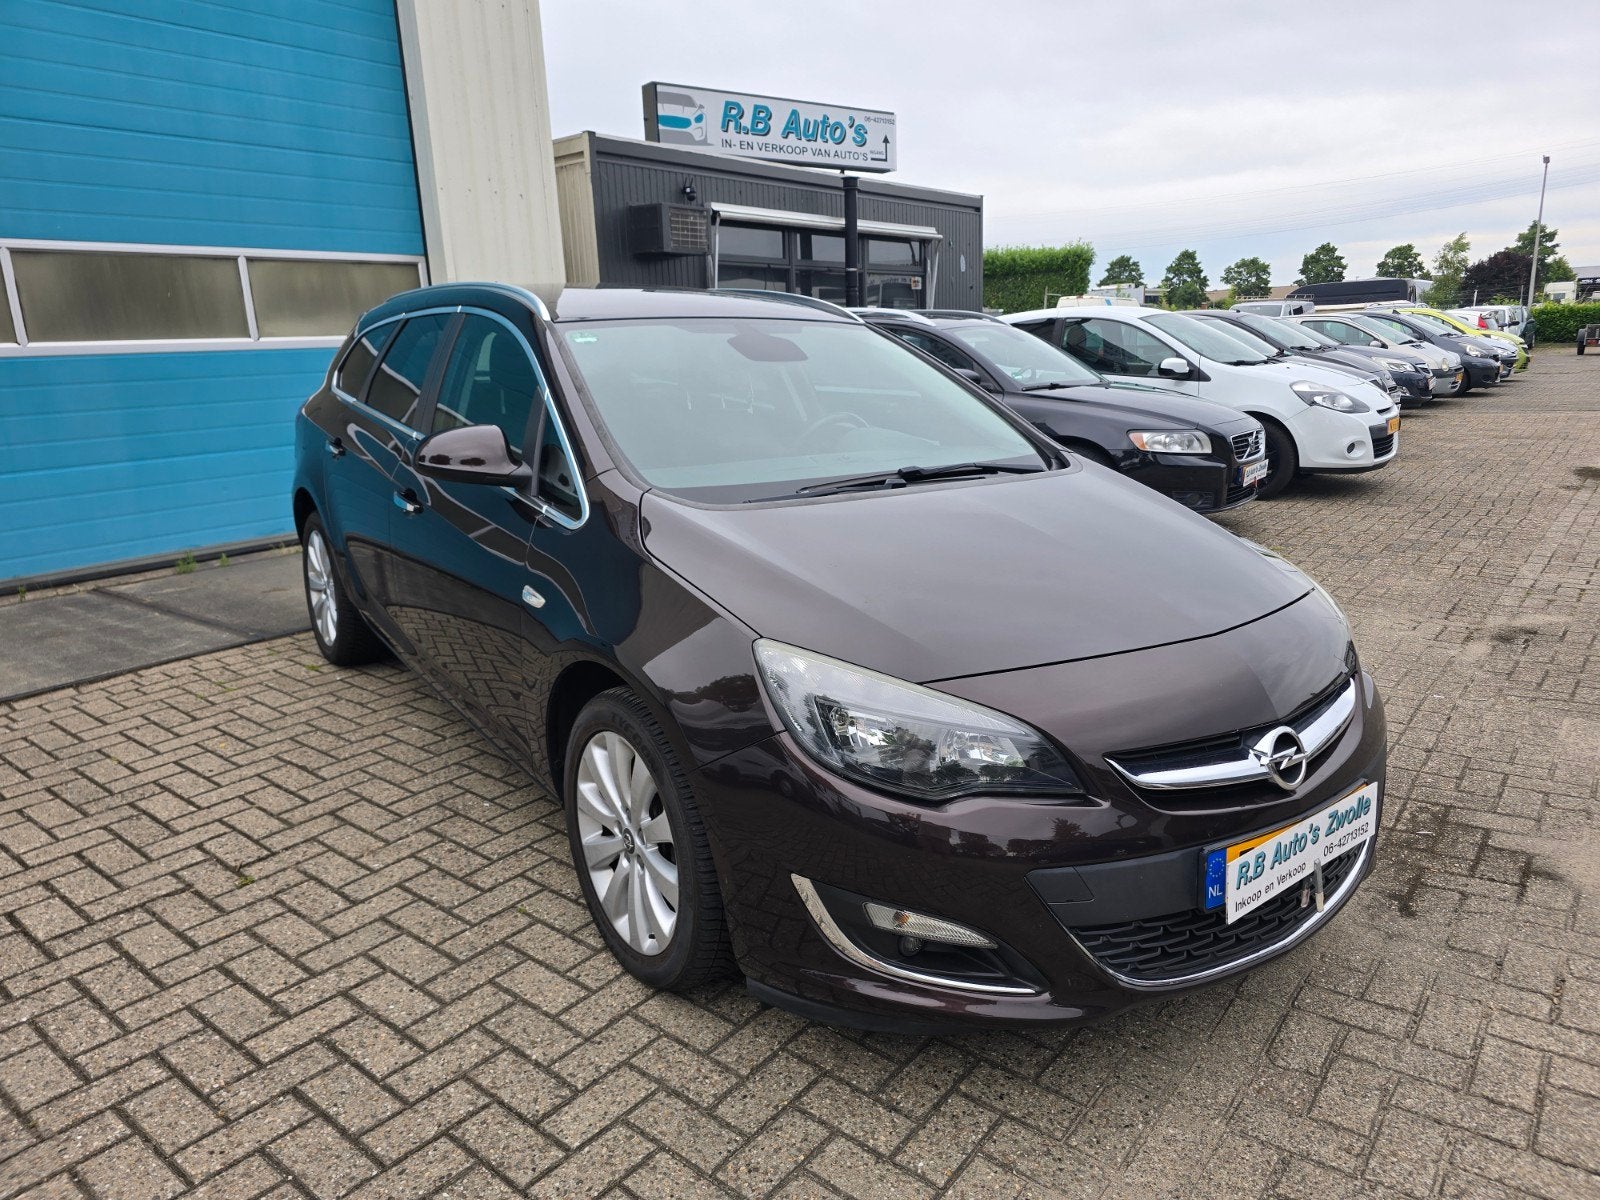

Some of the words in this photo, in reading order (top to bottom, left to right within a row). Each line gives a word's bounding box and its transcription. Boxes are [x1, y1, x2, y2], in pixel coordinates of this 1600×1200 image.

[720, 100, 772, 136] R.B
[781, 108, 868, 147] Auto's
[721, 138, 737, 149] IN-
[739, 140, 754, 151] EN
[756, 142, 808, 156] VERKOOP
[811, 147, 831, 159] VAN
[832, 149, 869, 162] AUTO'S
[1235, 851, 1266, 890] R.B
[1269, 823, 1320, 870] Auto's
[1324, 795, 1372, 837] Zwolle
[1323, 822, 1369, 857] 06-42713152
[1208, 884, 1223, 899] NL
[1235, 889, 1262, 912] Inkoop
[1264, 882, 1275, 894] en
[1276, 862, 1307, 886] Verkoop
